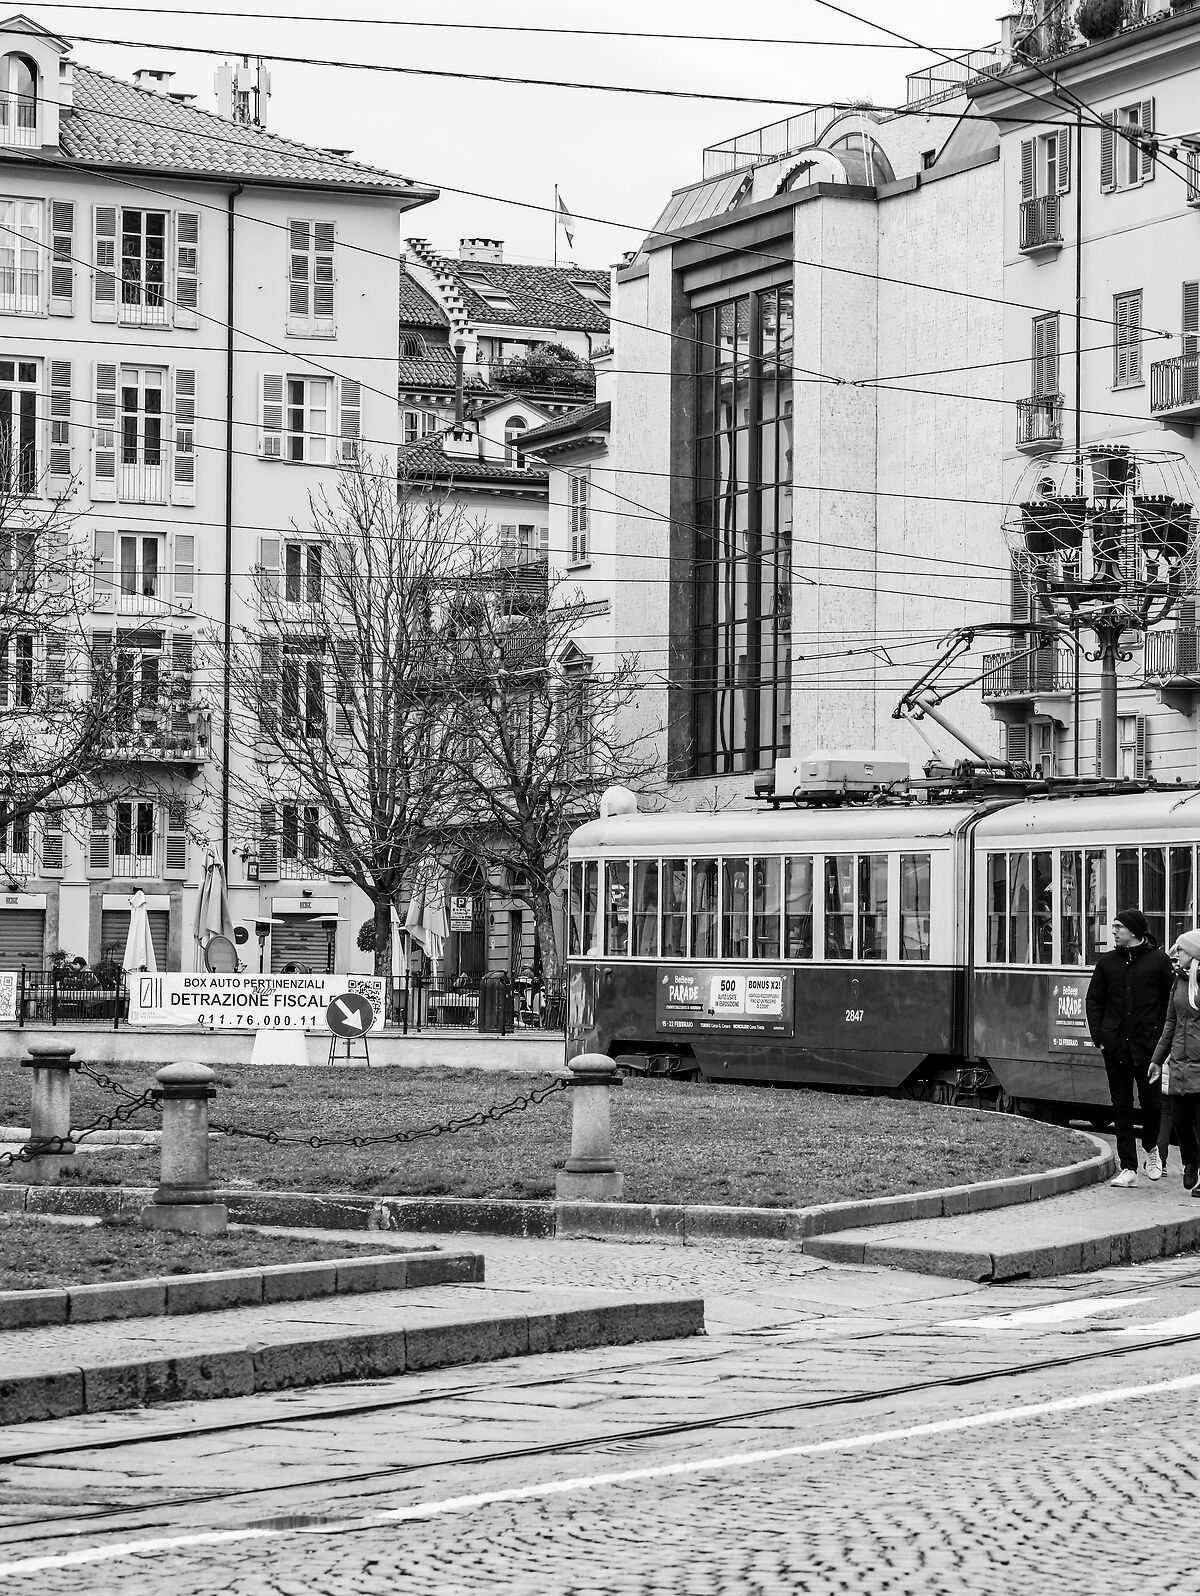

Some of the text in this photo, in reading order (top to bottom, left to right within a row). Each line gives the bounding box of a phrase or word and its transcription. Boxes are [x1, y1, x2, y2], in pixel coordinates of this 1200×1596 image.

[184, 978, 324, 989] BOX AUTO PERTINENZALI
[720, 980, 736, 991] 500
[748, 980, 781, 990] BONUS X2!
[669, 984, 699, 1003] PARADE
[171, 993, 269, 1007] DETRAZIONE
[1058, 996, 1082, 1018] PARADE
[846, 1010, 864, 1021] 2847
